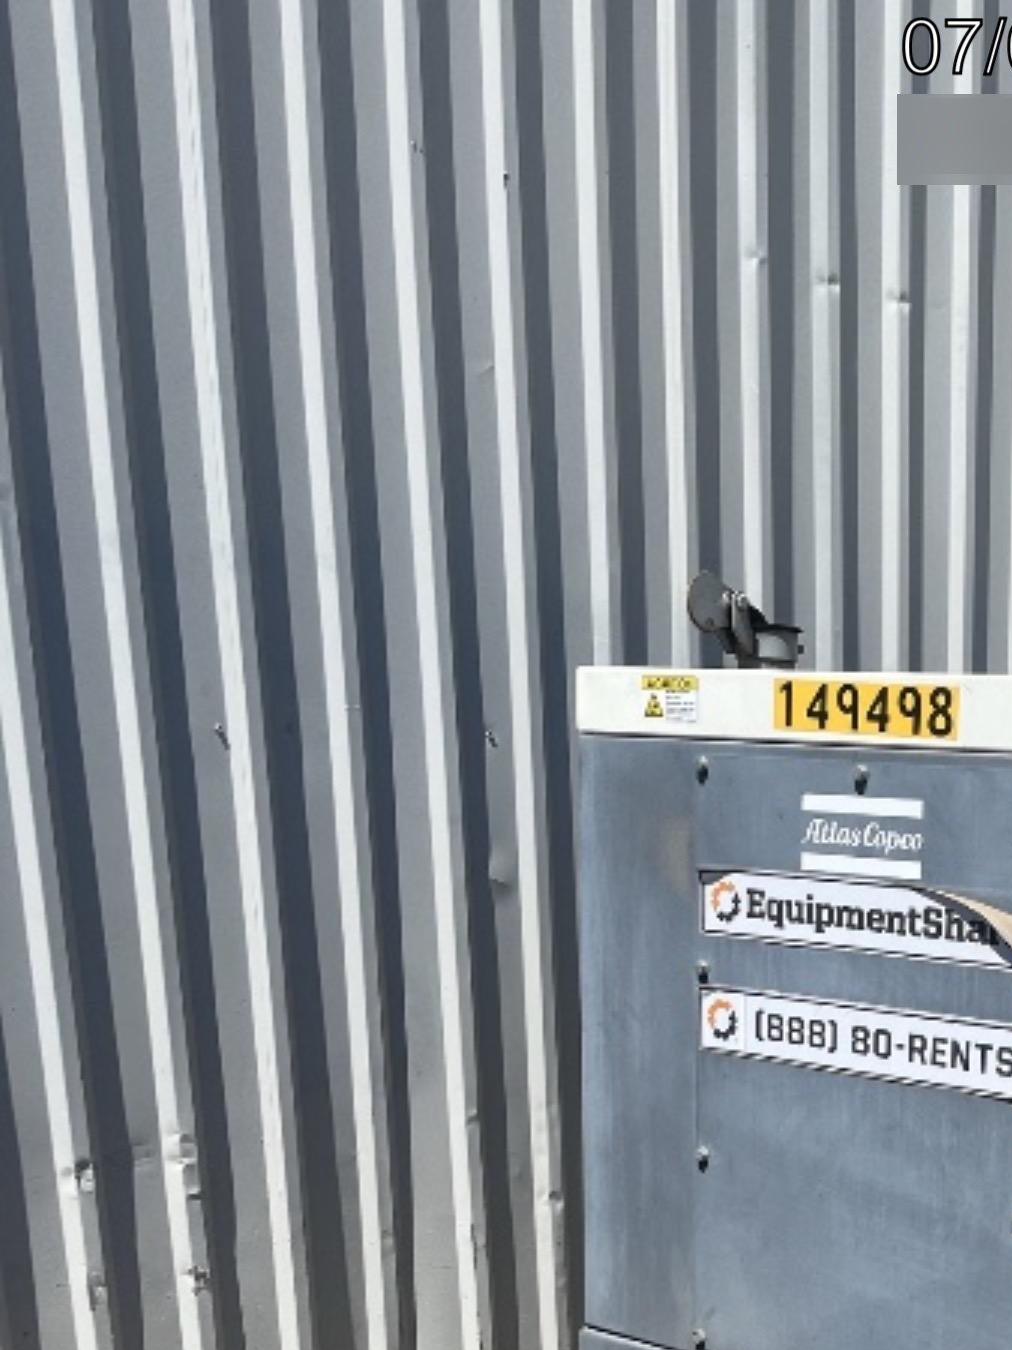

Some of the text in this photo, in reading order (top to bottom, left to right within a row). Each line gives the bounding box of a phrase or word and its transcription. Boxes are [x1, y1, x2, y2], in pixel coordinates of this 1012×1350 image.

[778, 680, 953, 737] 149498
[801, 818, 922, 854] Atlas Copco
[754, 1008, 838, 1054] (888)
